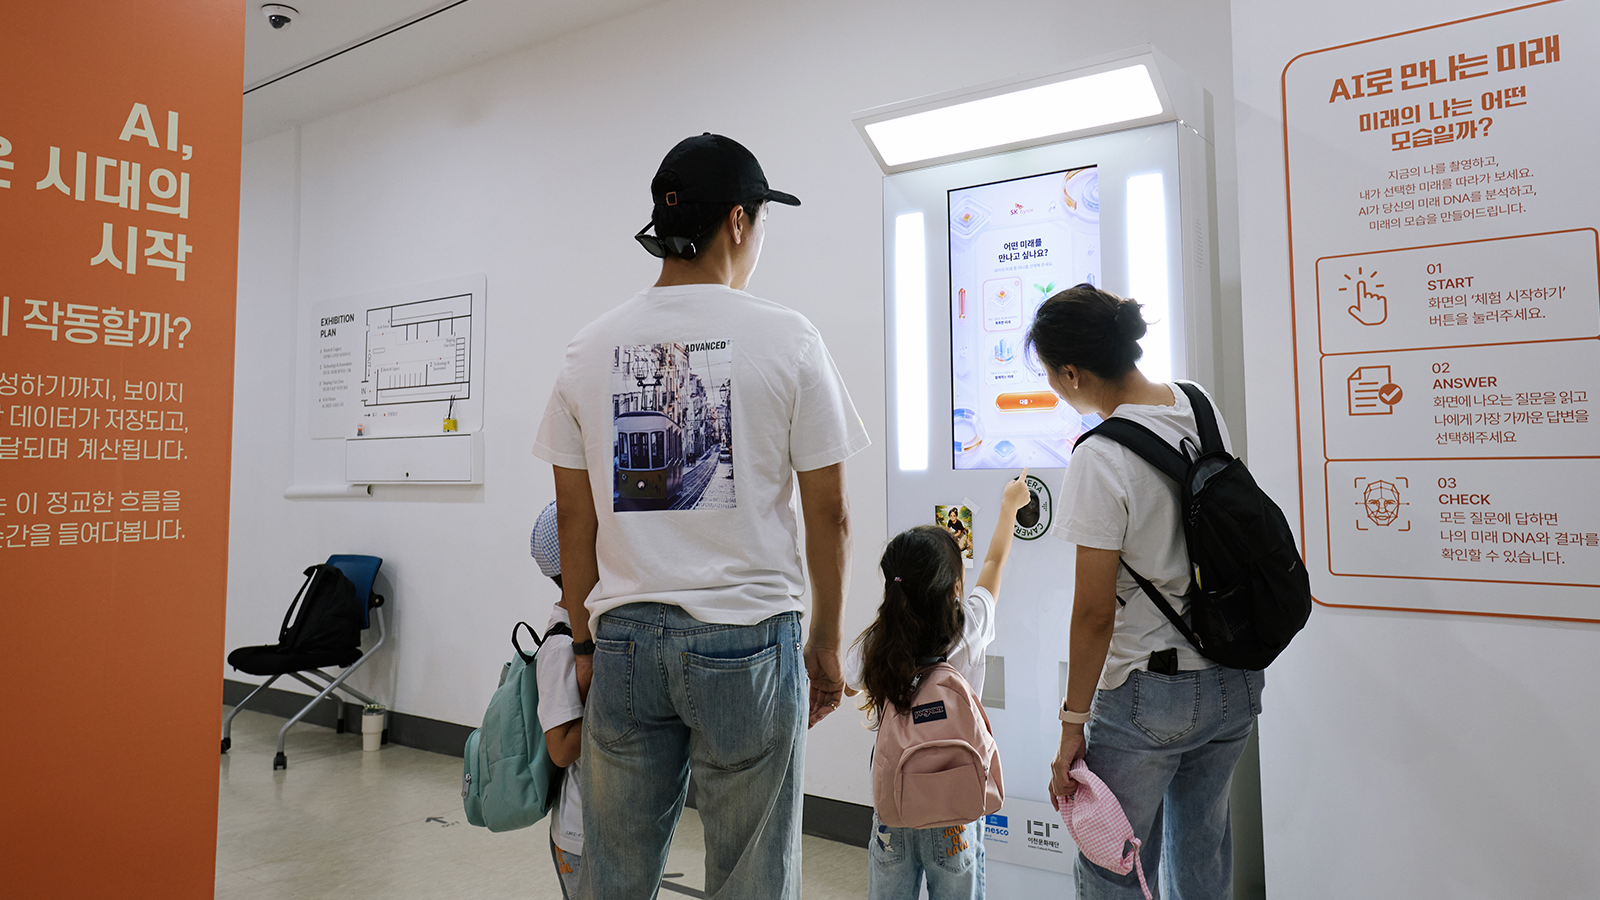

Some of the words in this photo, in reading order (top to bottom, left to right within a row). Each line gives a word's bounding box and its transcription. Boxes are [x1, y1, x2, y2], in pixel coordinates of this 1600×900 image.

[1328, 67, 1394, 104] AI로
[1400, 53, 1489, 91] 만나는
[1496, 34, 1561, 72] 미래
[1359, 104, 1421, 132] 미래의
[1429, 98, 1473, 120] 나는
[1481, 85, 1527, 110] 어떤
[119, 102, 193, 160] AI,
[1391, 116, 1494, 151] 모습일까?
[1387, 166, 1421, 180] 지금의
[1423, 163, 1447, 176] 나를
[1449, 155, 1500, 172] 촬영하고,
[36, 146, 190, 219] 시대의
[1359, 187, 1381, 201] 내가
[1383, 183, 1416, 198] 선택한
[1419, 179, 1453, 192] 미래를
[1455, 173, 1491, 188] 따라가
[1494, 167, 1534, 183] 보세요.
[1358, 203, 1380, 217] AI가
[1382, 199, 1415, 214] 당신의
[1417, 196, 1441, 209] 미래
[1443, 191, 1482, 206] DNA를
[1485, 184, 1537, 201] 분석하고,
[1010, 208, 1018, 216] SK
[1369, 217, 1401, 231] 미래의
[1404, 213, 1437, 227] 모습을
[1440, 202, 1527, 222] 만들어드립니다.
[90, 222, 193, 281] 시작
[1003, 241, 1019, 251] 어떤
[1020, 238, 1042, 248] 미래를
[998, 252, 1020, 263] 만나고
[1022, 248, 1049, 260] 싶나요?
[1426, 263, 1443, 275] 01
[1427, 276, 1474, 291] START
[1428, 295, 1468, 309] 화면의
[23, 299, 192, 350] 작동할까?
[320, 313, 355, 326] EXHIBITION
[1429, 313, 1468, 327] 버튼을
[1472, 307, 1546, 324] 눌러주세요.
[320, 328, 336, 338] PLAN
[685, 341, 726, 352] ADVANCED
[1431, 362, 1450, 374] 02
[1432, 376, 1497, 389] ANSWER
[124, 380, 183, 403] 보이지
[1433, 395, 1471, 408] 화면에
[1474, 393, 1514, 407] 나오는
[1515, 391, 1556, 405] 질문을
[1558, 390, 1588, 404] 읽고
[10, 405, 100, 430] 데이터가
[105, 408, 189, 433] 저장되고,
[1434, 413, 1473, 426] 나에게
[1475, 412, 1501, 425] 가장
[1503, 411, 1544, 425] 가까운
[1546, 409, 1589, 424] 답변을
[1435, 430, 1517, 445] 선택해주세요
[0, 436, 68, 460] 달되며
[77, 438, 188, 461] 계산됩니다.
[1024, 479, 1043, 493] ERA
[1437, 477, 1457, 489] 03
[16, 492, 38, 515] 이
[47, 491, 114, 515] 정교한
[120, 490, 181, 512] 흐름을
[1438, 493, 1491, 506] CHECK
[1439, 511, 1466, 524] 모든
[1469, 511, 1511, 525] 질문에
[1515, 512, 1559, 526] 답하면
[0, 523, 51, 548] 간을
[58, 519, 185, 546] 들여다봅니다.
[1440, 530, 1467, 543] 나의
[1471, 530, 1499, 544] 미래
[1502, 531, 1550, 545] DNA와
[1554, 532, 1600, 547] 결과를
[1441, 548, 1482, 563] 확인할
[1485, 550, 1500, 563] 수
[1503, 550, 1566, 565] 있습니다.
[985, 827, 1009, 836] nesco
[1027, 837, 1060, 848] 이천문화재단
